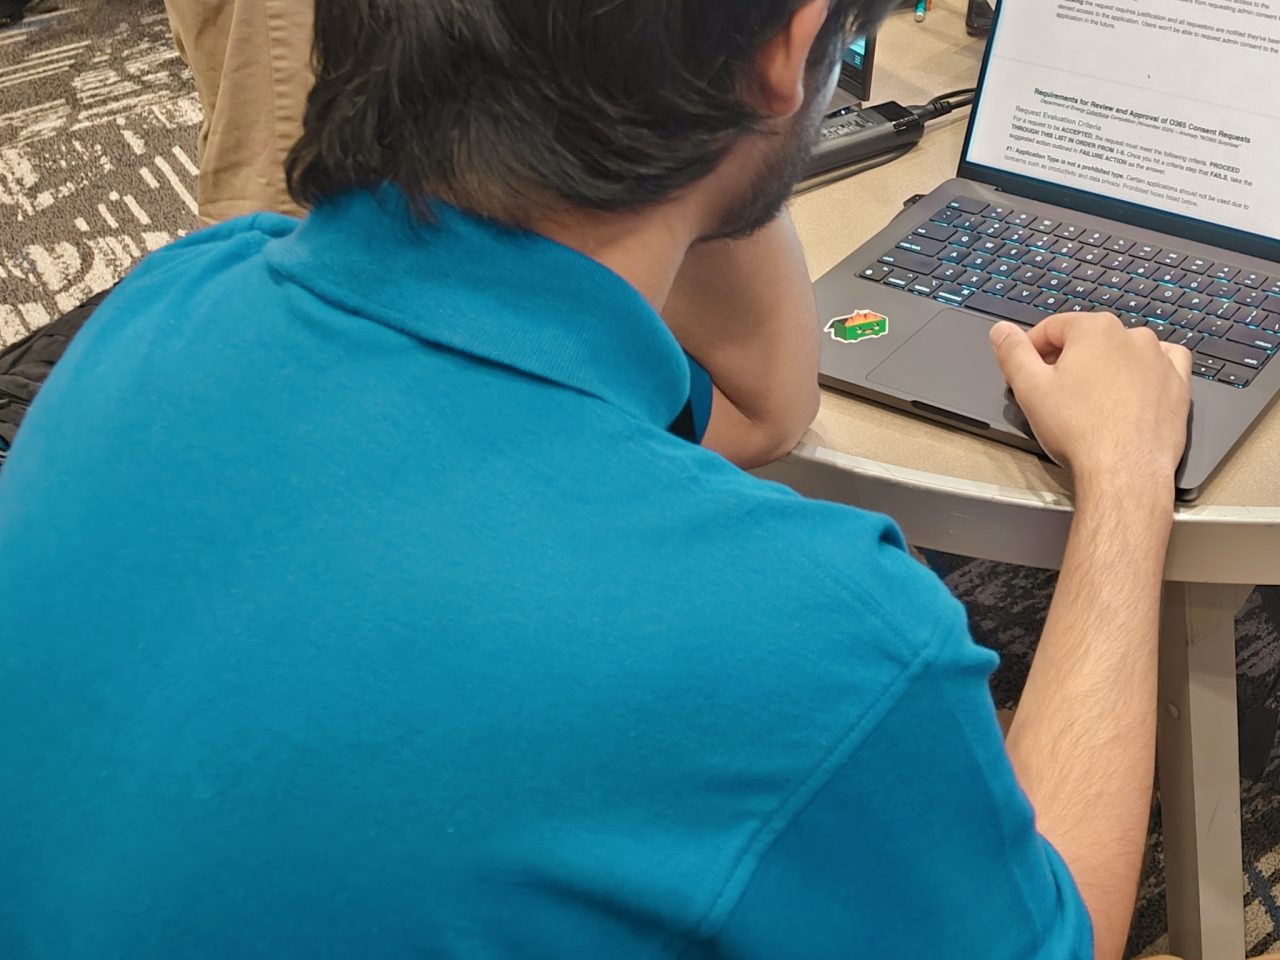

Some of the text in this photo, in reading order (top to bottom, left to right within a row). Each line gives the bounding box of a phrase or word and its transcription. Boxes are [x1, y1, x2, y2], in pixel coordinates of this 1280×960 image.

[1014, 105, 1101, 130] Request Evaluation Criteria
[1033, 88, 1078, 104] Requirements
[1090, 101, 1114, 111] Review
[1115, 106, 1128, 114] and
[1128, 110, 1159, 123] Approval
[1168, 119, 1186, 128] O365
[1187, 123, 1216, 135] Consent
[1218, 130, 1250, 144] Requests
[1008, 132, 1035, 144] suggested
[1035, 138, 1051, 147] action
[1051, 142, 1072, 152] outlined
[1078, 149, 1104, 159] FAILURE
[1104, 155, 1127, 165] ACTION
[1011, 124, 1039, 135] THROUGH
[1074, 139, 1096, 148] ORDER
[1096, 144, 1114, 152] FROM
[1126, 151, 1141, 160] Once
[1165, 161, 1184, 170] criteria
[1184, 165, 1197, 174] step
[1210, 171, 1228, 180] FAILS,
[1026, 119, 1046, 128] request
[1060, 126, 1094, 138] ACCEPTED,
[1104, 136, 1124, 146] request
[1162, 151, 1187, 162] following
[1209, 161, 1240, 173] PROCEED
[1014, 148, 1045, 160] Application
[1045, 155, 1060, 164] Type
[1081, 164, 1110, 176] prohibited
[1110, 171, 1124, 179] type.
[1126, 175, 1145, 184] Certain
[1146, 180, 1177, 193] applications
[1178, 187, 1197, 197] should
[1216, 196, 1230, 204] used
